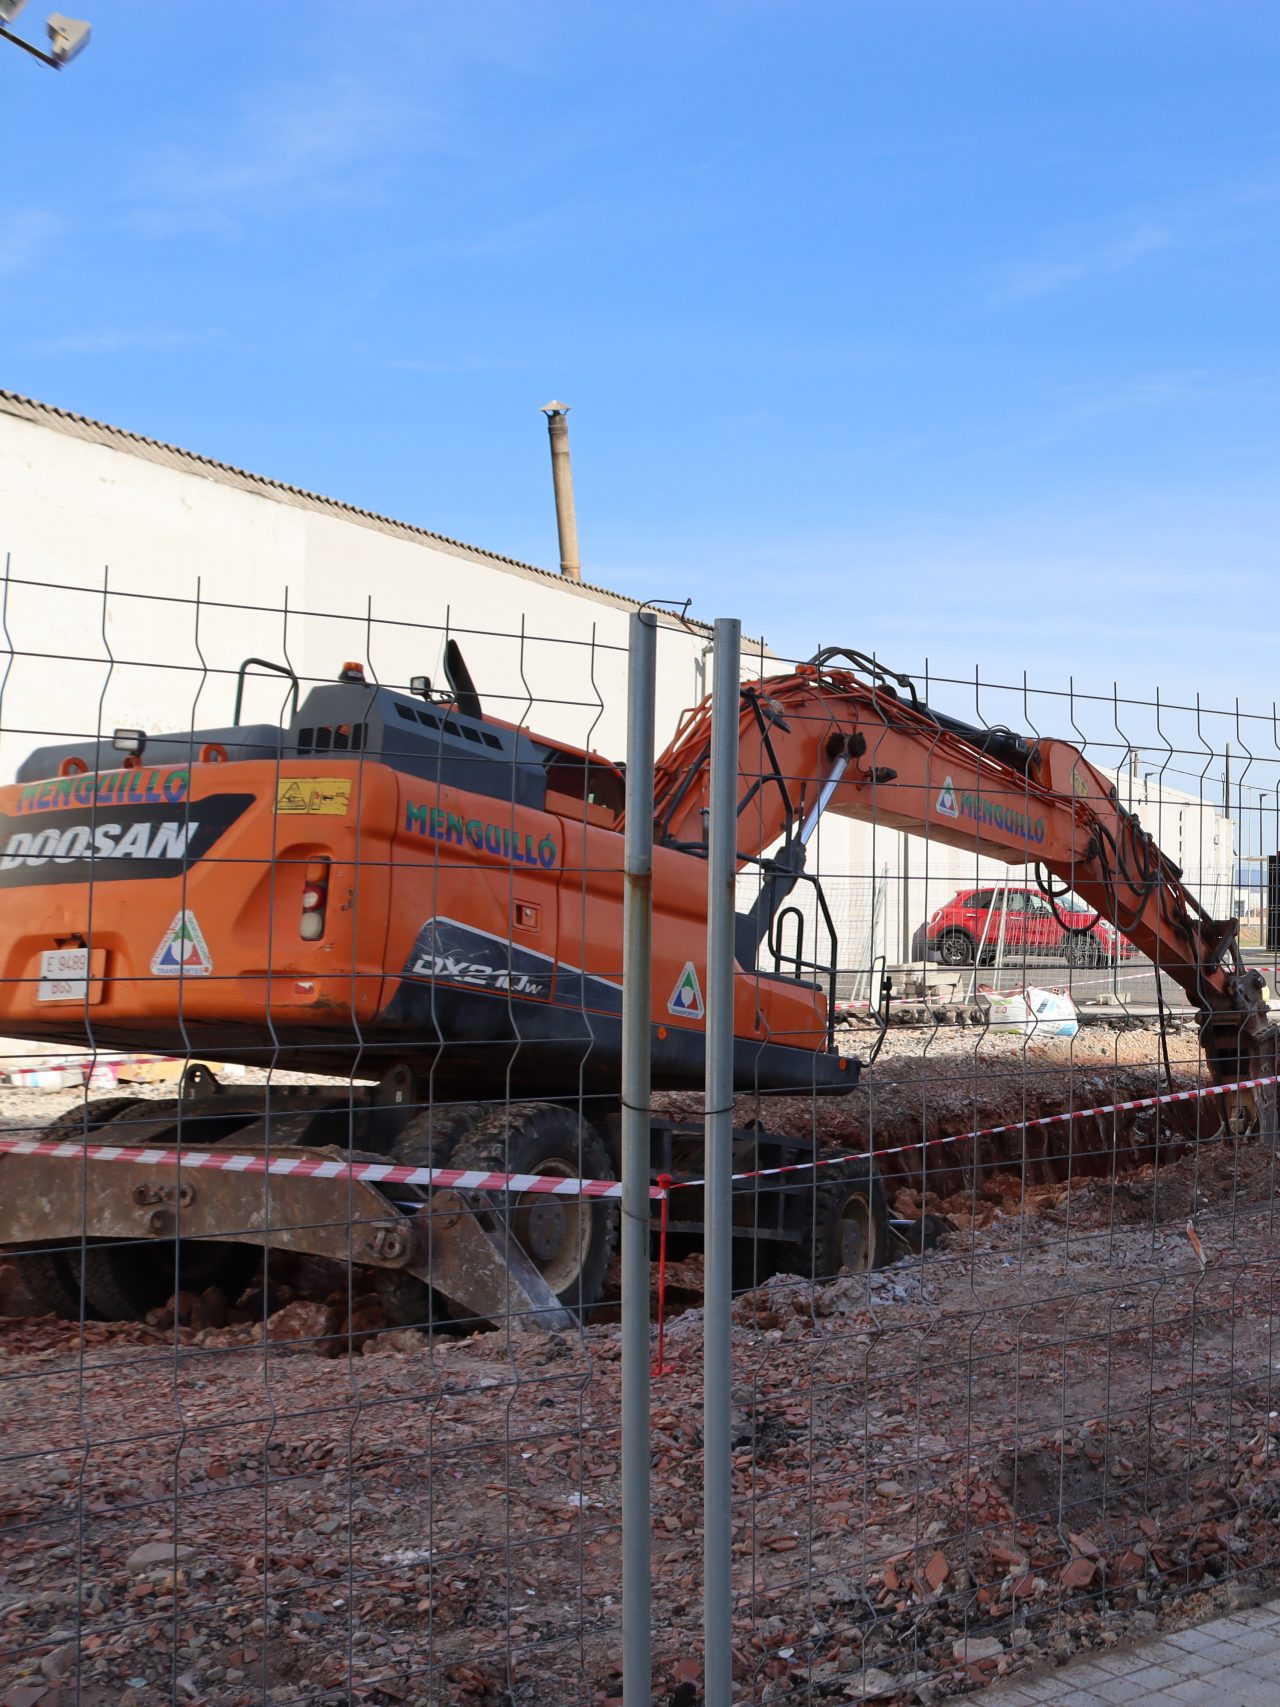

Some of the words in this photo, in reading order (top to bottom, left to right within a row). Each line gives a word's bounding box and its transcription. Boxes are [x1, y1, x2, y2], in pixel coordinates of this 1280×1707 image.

[0, 821, 200, 870] DOOSAN
[405, 799, 557, 868] MENGUILLÓ
[47, 956, 55, 972] E
